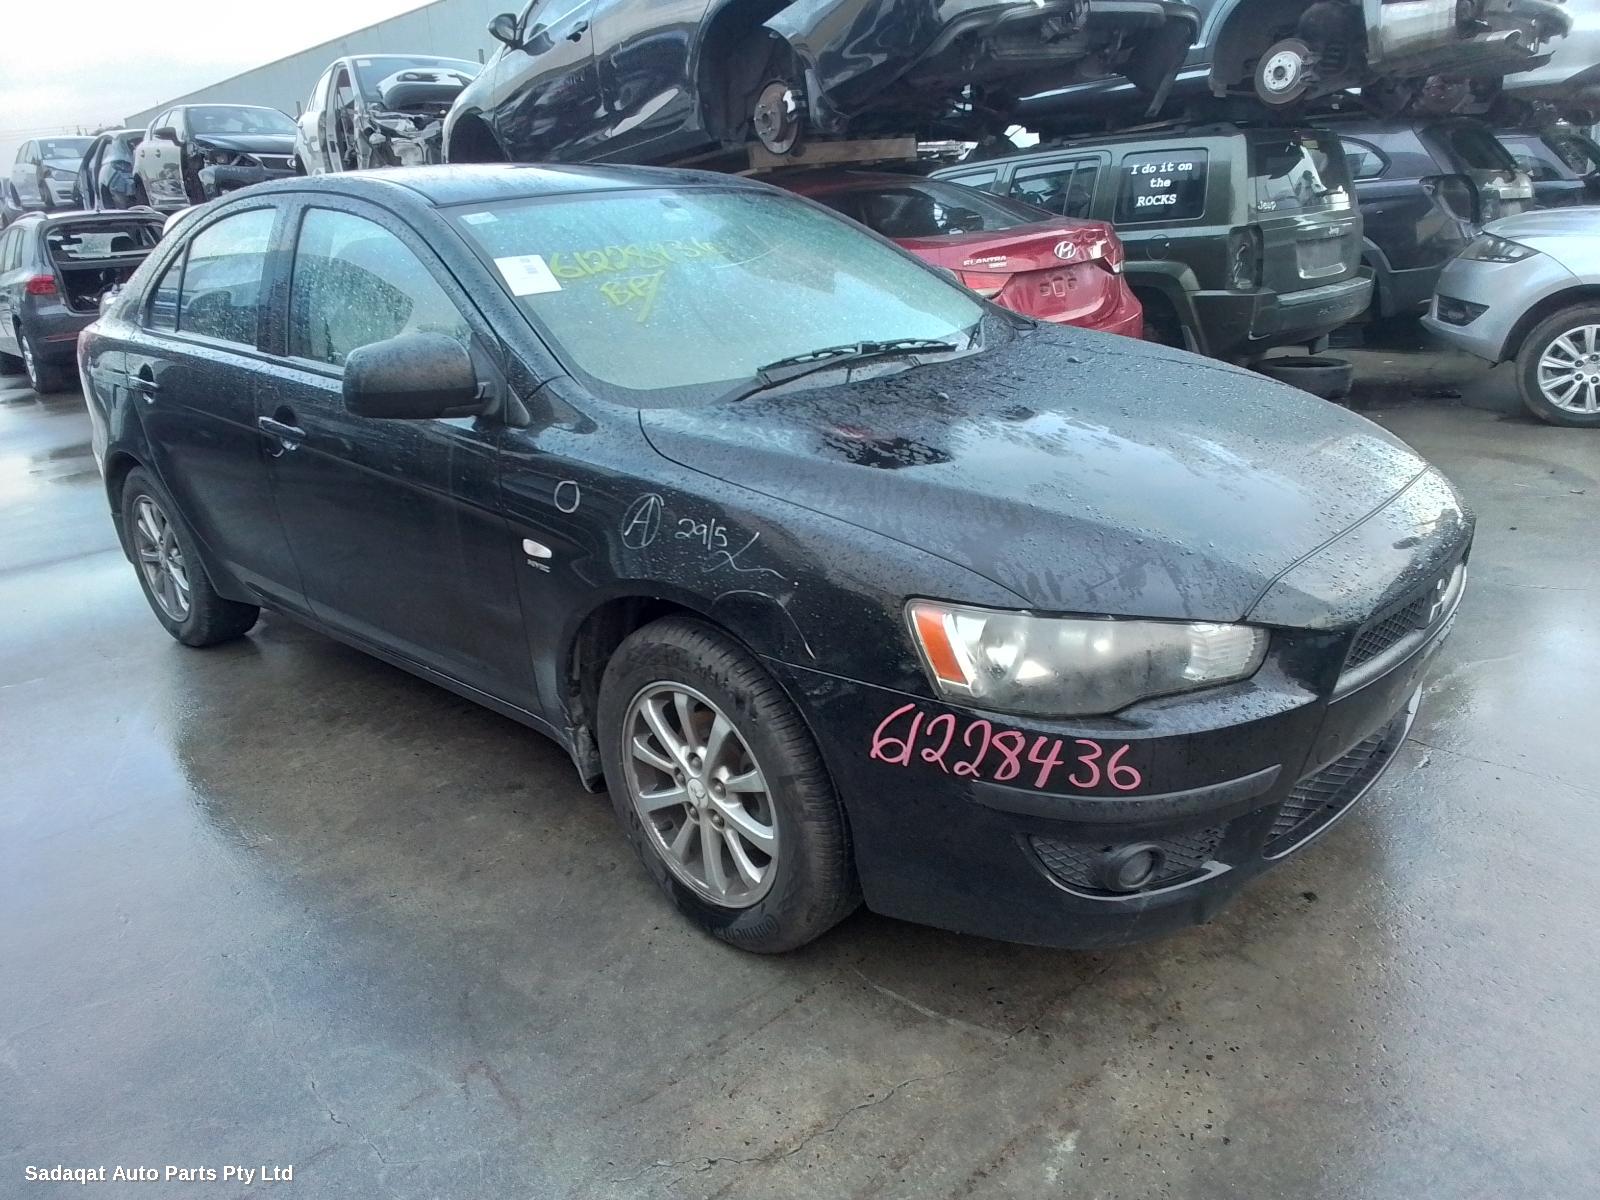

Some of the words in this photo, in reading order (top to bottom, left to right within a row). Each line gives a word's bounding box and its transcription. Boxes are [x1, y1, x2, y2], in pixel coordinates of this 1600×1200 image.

[1130, 164, 1140, 175] I
[1141, 163, 1157, 174] do
[1159, 161, 1175, 173] it
[1177, 162, 1193, 172] on
[1150, 177, 1172, 188] the
[1135, 193, 1177, 207] ROCKS
[869, 703, 1142, 791] 61228436
